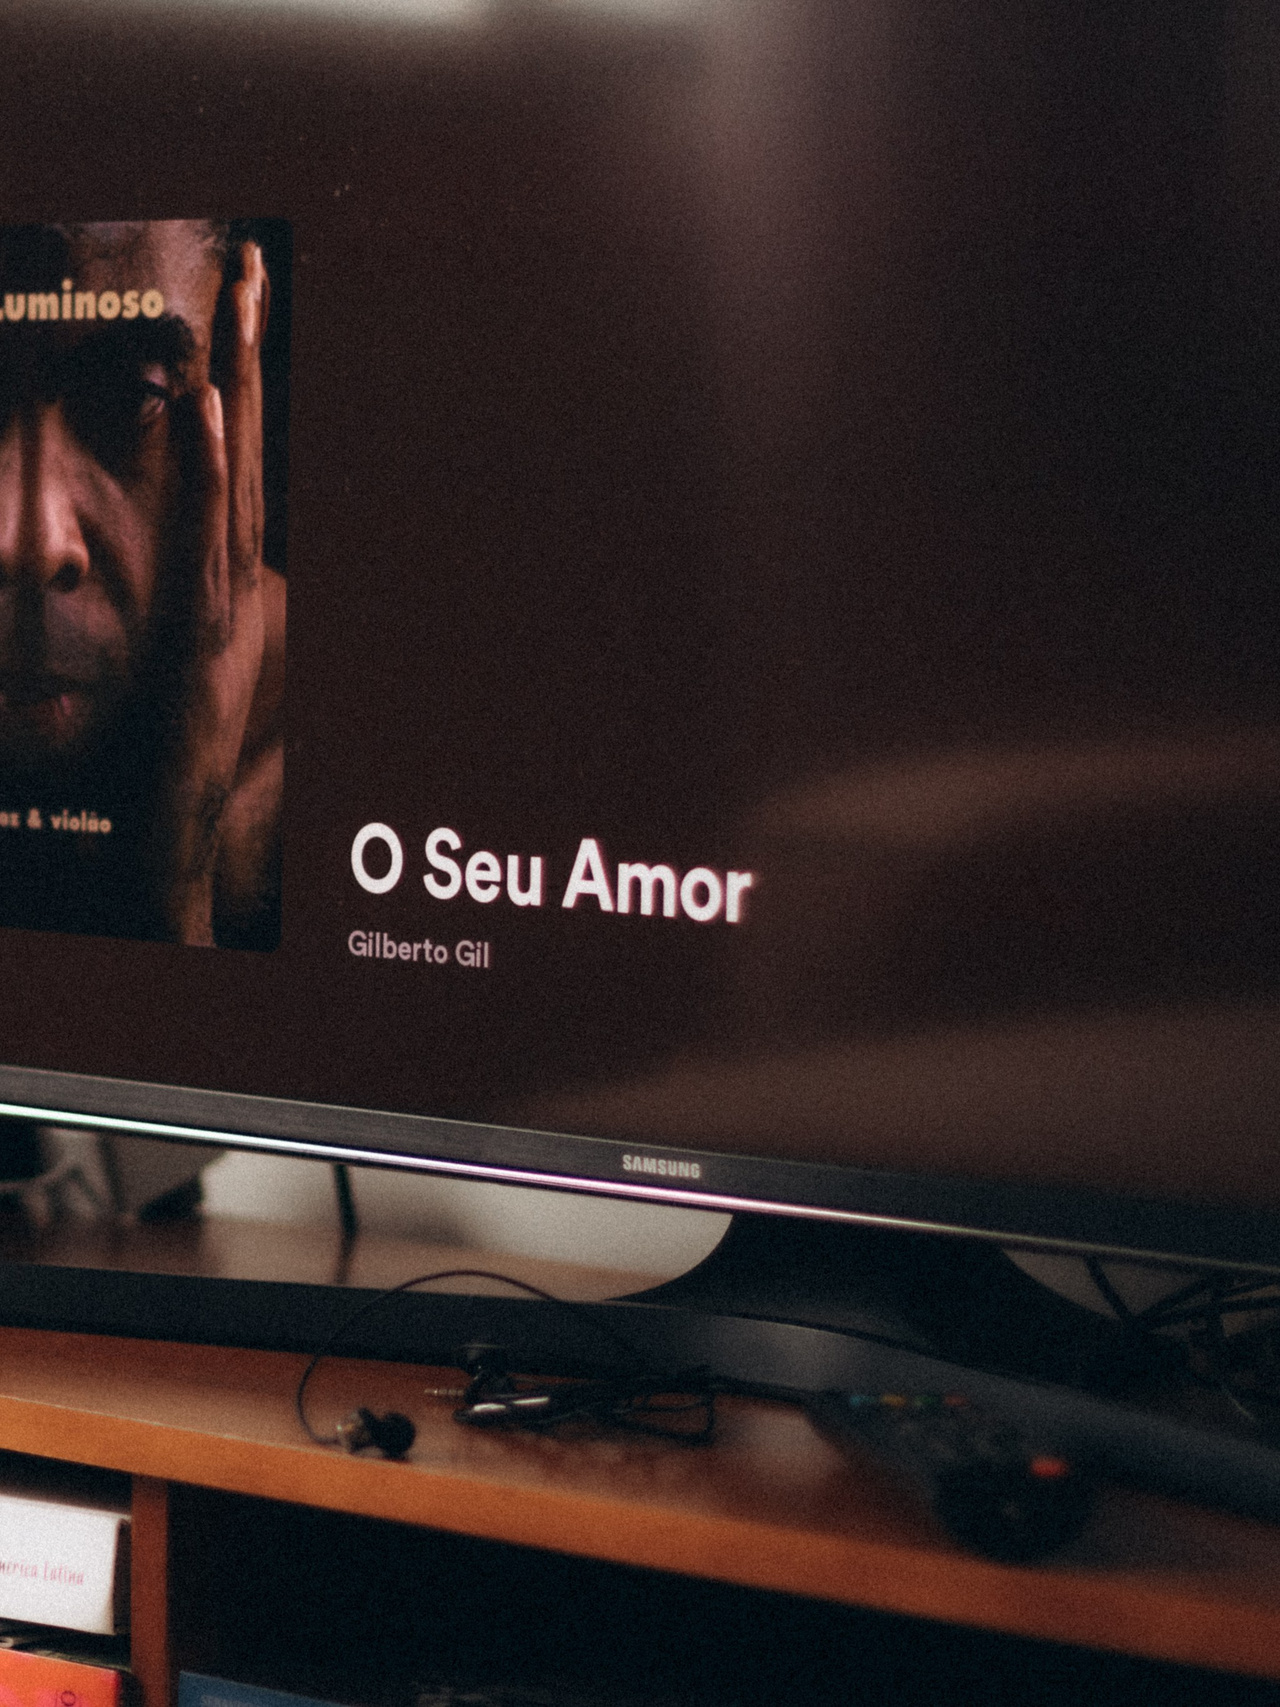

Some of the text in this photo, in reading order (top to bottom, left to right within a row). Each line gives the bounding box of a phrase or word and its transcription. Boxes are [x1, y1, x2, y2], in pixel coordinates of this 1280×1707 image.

[27, 807, 42, 829] &
[351, 822, 753, 923] O Seu Amor
[348, 930, 490, 969] Gilberto Gil
[622, 1154, 701, 1179] SAMSUNG
[43, 1560, 84, 1585] Latina
